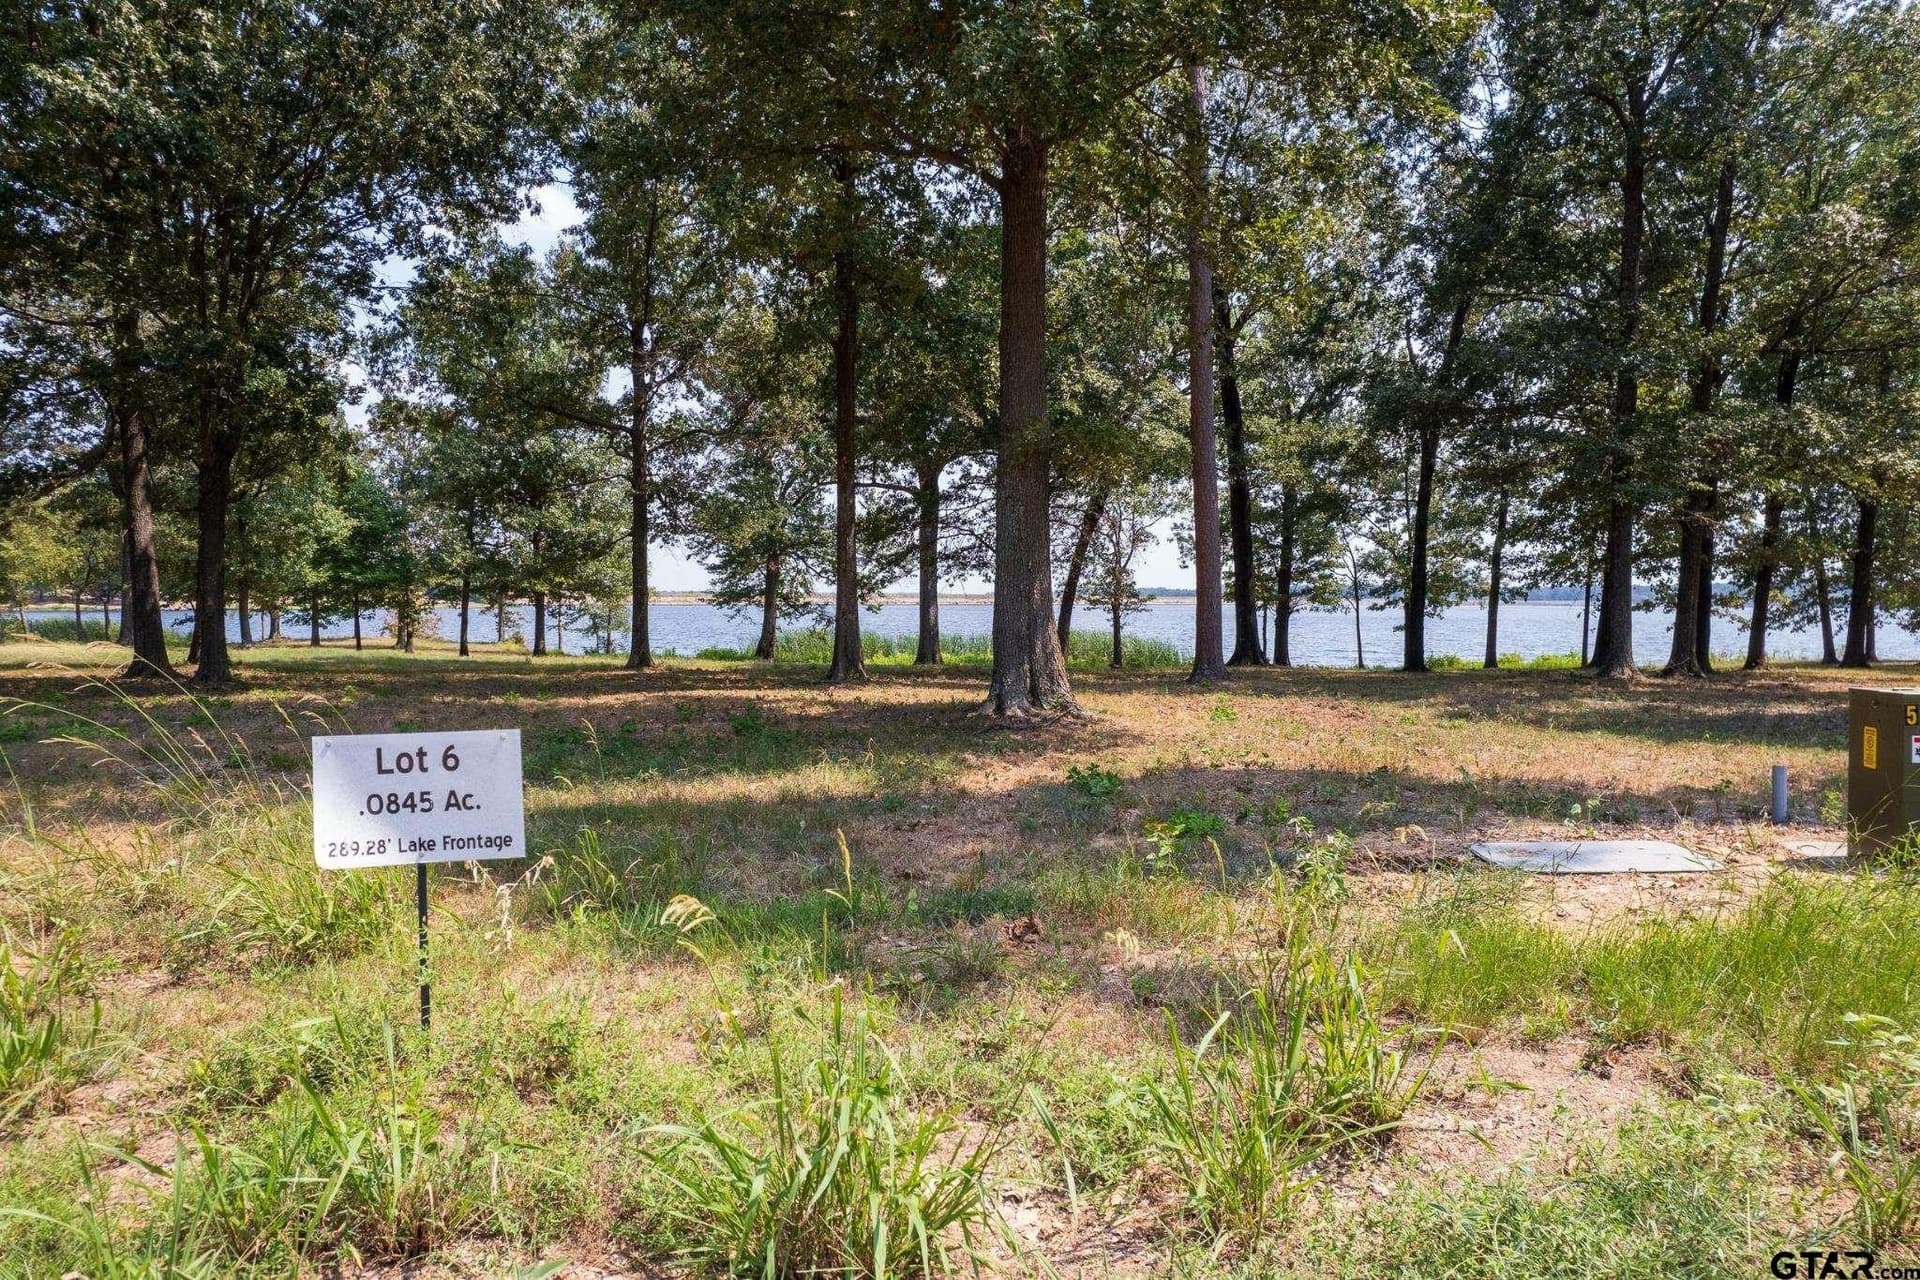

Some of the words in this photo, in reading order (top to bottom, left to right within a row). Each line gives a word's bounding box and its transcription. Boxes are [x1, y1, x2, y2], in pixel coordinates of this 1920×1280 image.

[1906, 705, 1918, 726] 5
[376, 746, 429, 775] Lot
[442, 744, 460, 772] 6
[359, 791, 434, 816] .0845
[444, 790, 481, 812] Ac.
[398, 836, 437, 853] Lake
[442, 834, 513, 852] Frontage
